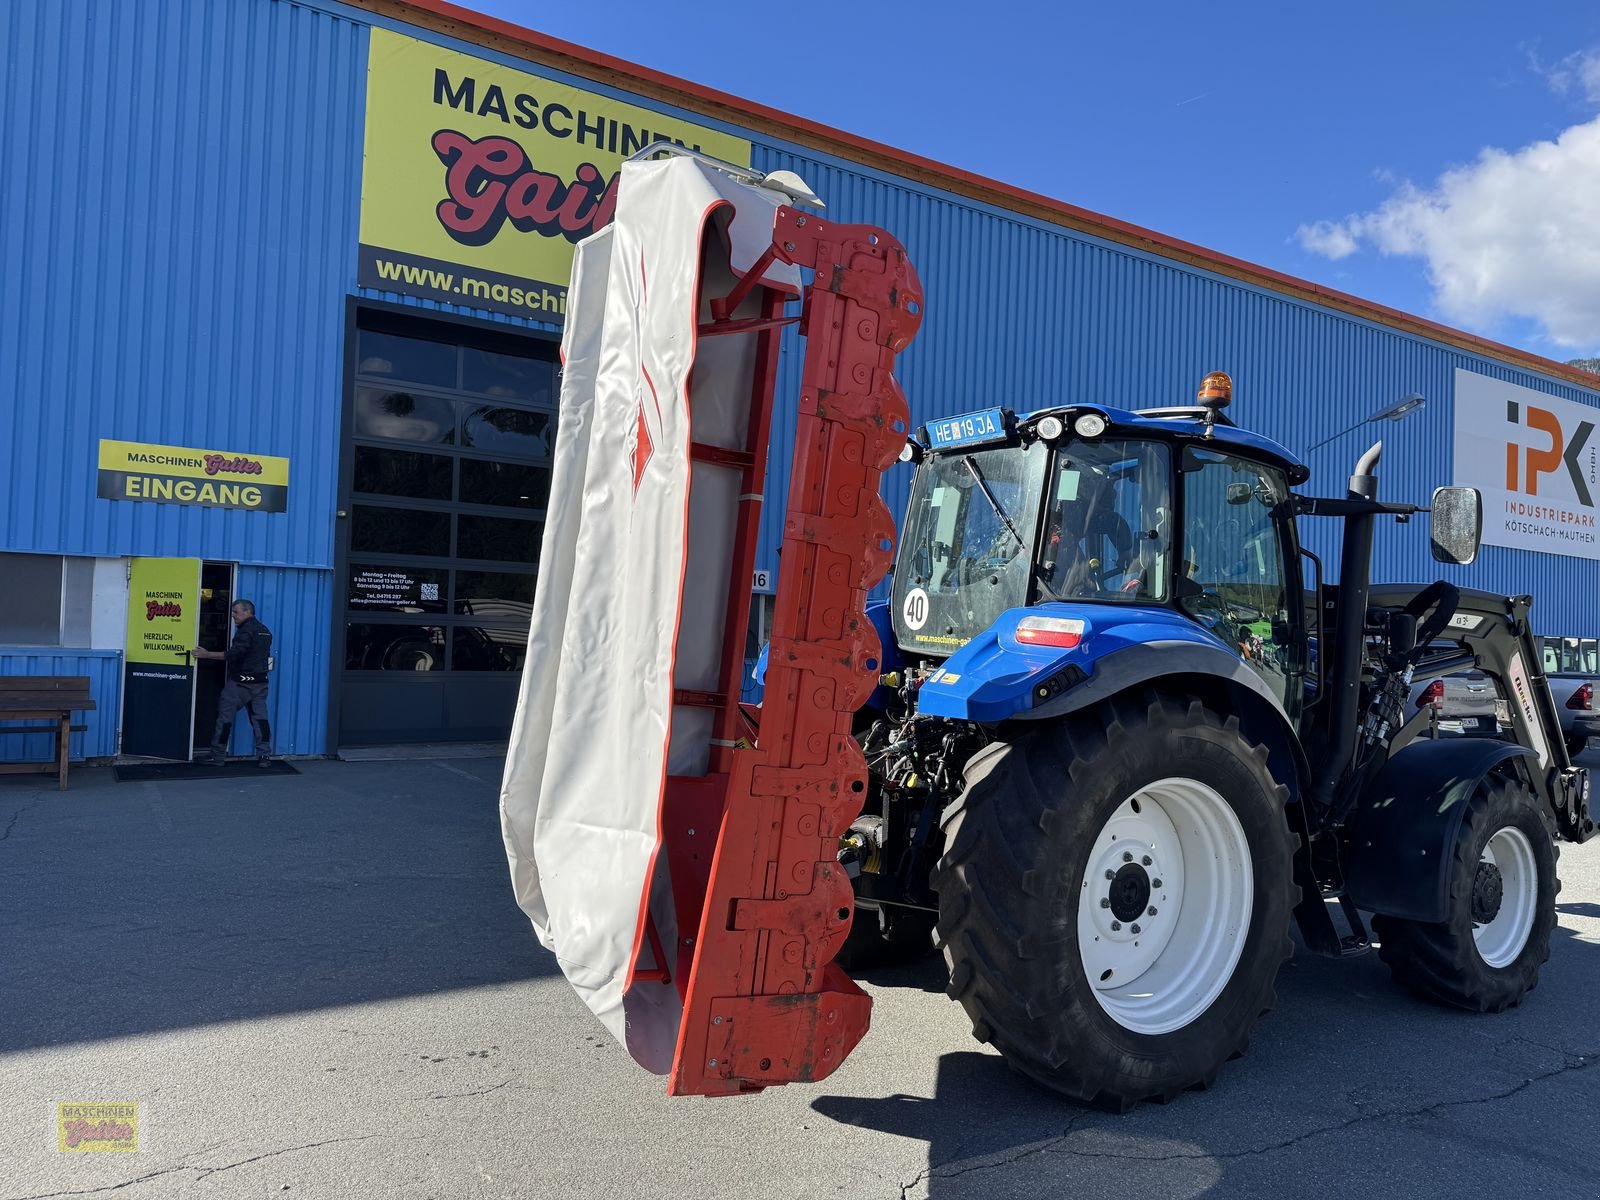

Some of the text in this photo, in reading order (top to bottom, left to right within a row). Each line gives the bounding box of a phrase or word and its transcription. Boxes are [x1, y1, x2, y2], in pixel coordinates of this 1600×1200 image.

[433, 68, 701, 161] MASCHINE
[376, 259, 566, 314] www.maschi
[935, 415, 995, 443] HE 19 JA
[127, 452, 263, 476] MASCHINEN Gailer
[125, 475, 262, 506] EINGANG
[1505, 500, 1595, 528] INDUSTRIEPARK
[1505, 519, 1596, 544] KÖTSCHACH-MAUTHEN
[145, 591, 183, 599] MASCHINEN
[146, 600, 182, 621] Gailer
[906, 595, 924, 623] 40
[143, 633, 173, 641] HERZLICH
[143, 643, 185, 652] WILLKOMMEN
